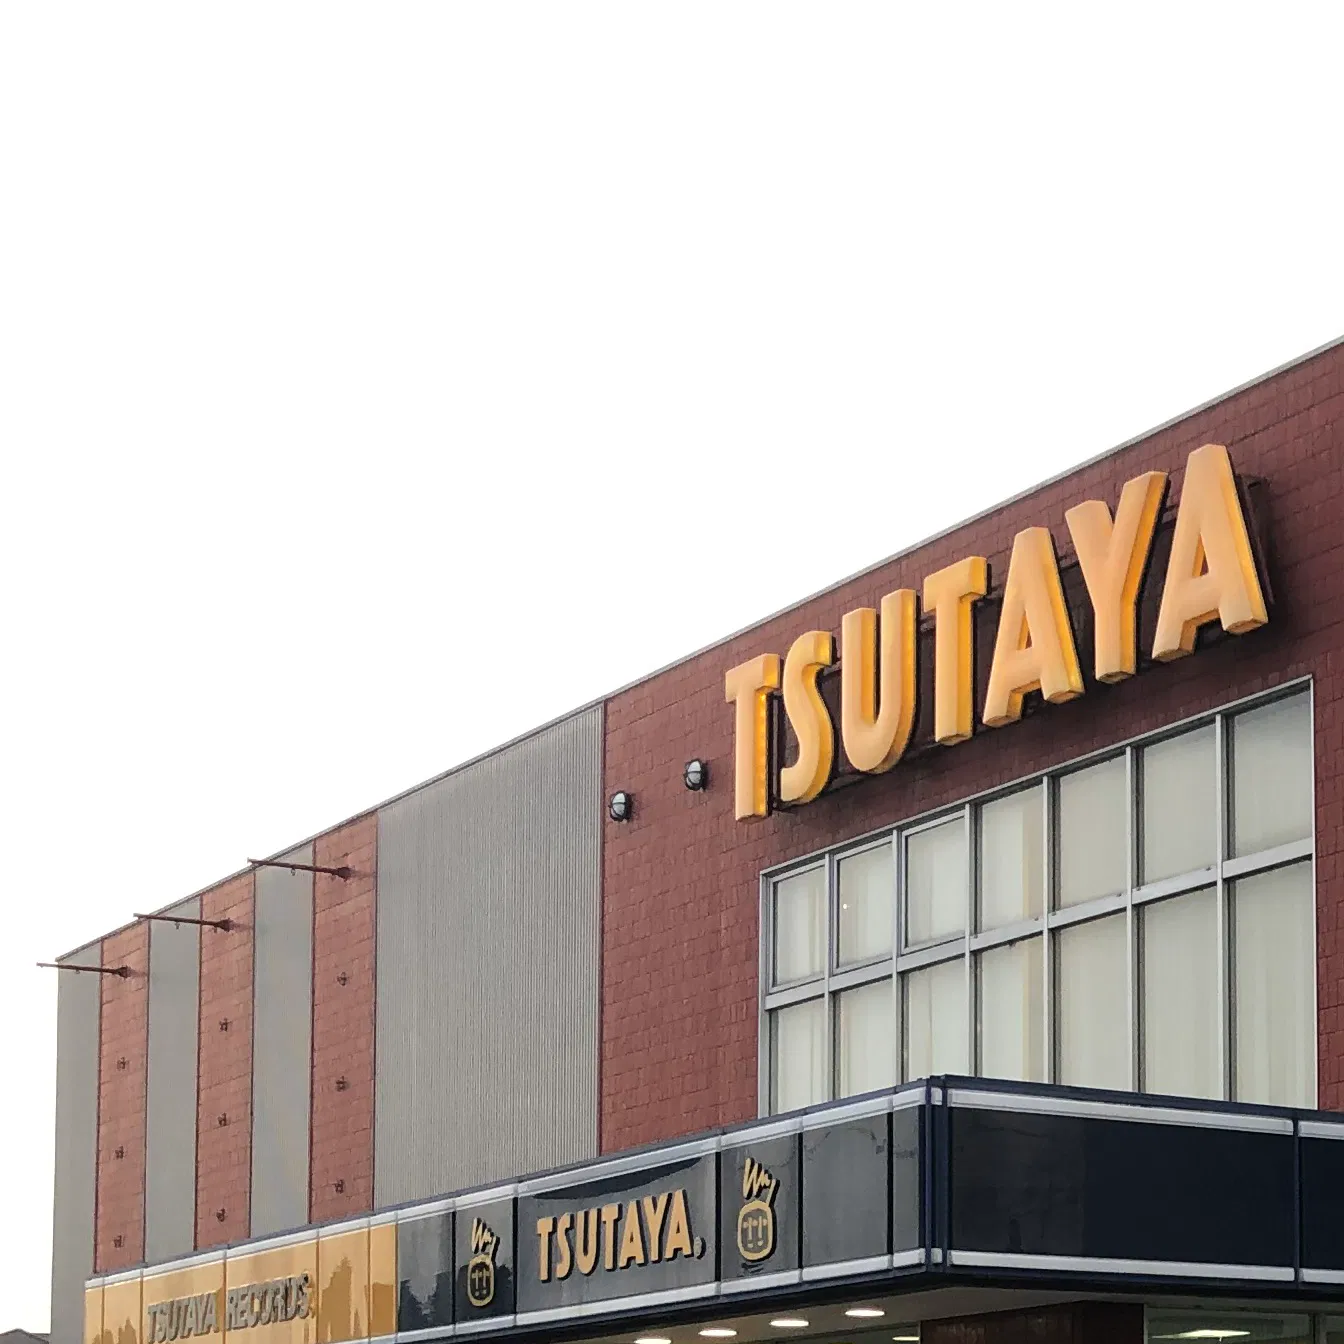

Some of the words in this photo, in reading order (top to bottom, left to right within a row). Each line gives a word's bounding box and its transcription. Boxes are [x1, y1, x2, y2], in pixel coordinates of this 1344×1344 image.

[725, 443, 1268, 823] TSUTAYA
[536, 1189, 694, 1281] TSUTAYA
[147, 1292, 220, 1344] TSUTAYA
[226, 1271, 312, 1332] RECORDS
